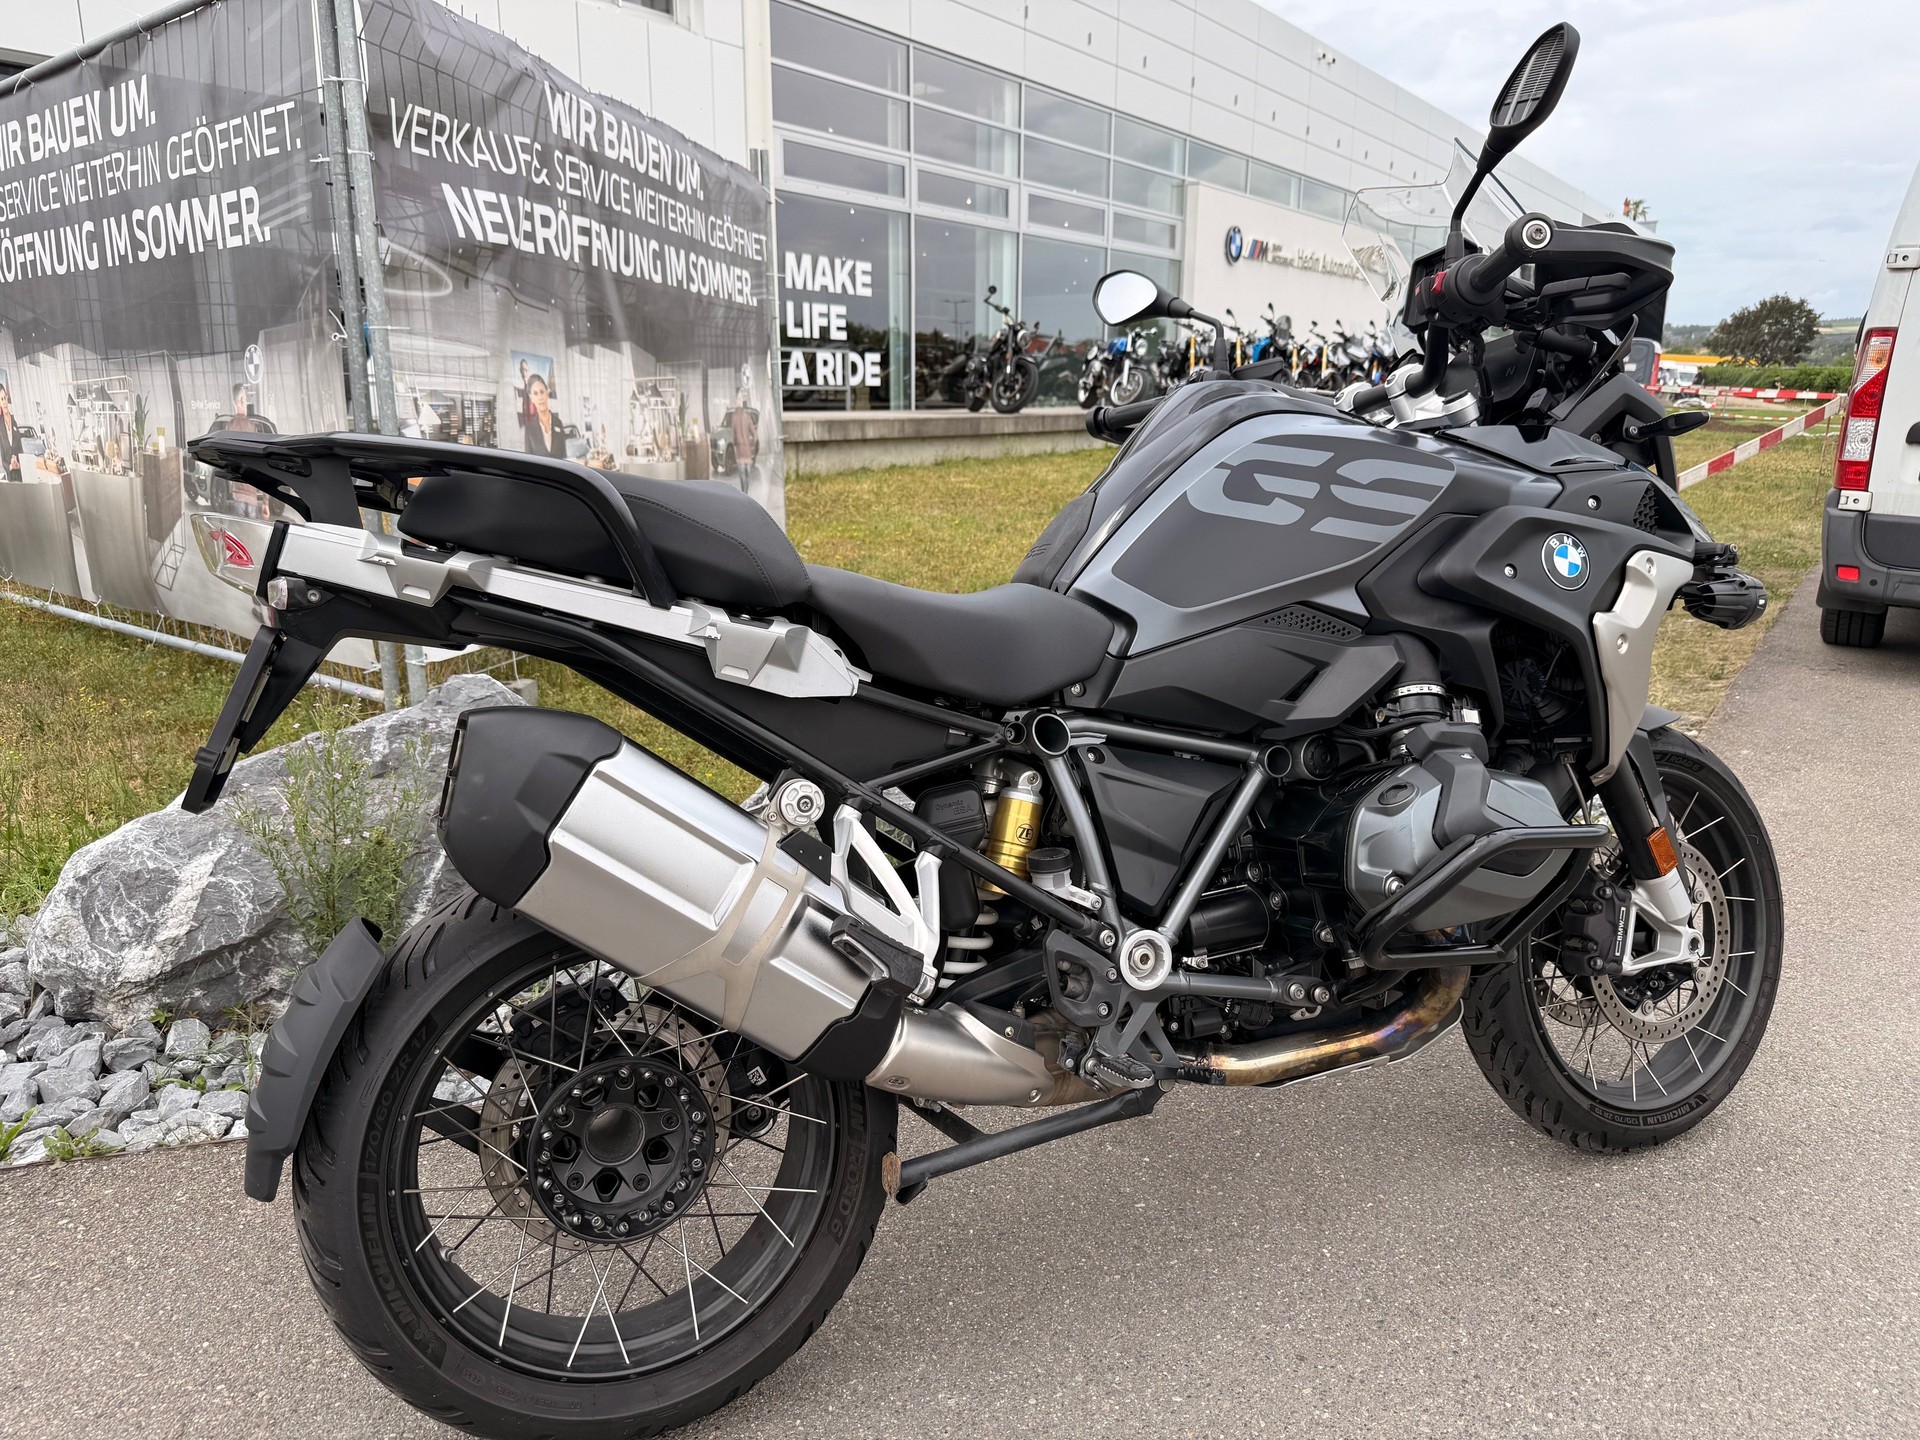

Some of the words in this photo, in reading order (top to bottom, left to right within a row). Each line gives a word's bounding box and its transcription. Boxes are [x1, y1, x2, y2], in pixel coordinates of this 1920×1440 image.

[26, 90, 102, 163] BAUEN
[110, 74, 156, 137] UM.
[60, 144, 161, 206] WEITERHIN
[166, 101, 301, 180] GEÖFFNET.
[544, 80, 598, 152] WIR
[602, 109, 671, 186] BAUEN
[675, 149, 704, 201] UM.
[390, 97, 531, 177] VERKAUF
[531, 142, 551, 186] &
[554, 149, 631, 215] SERVICE
[632, 182, 706, 243] WEITERHIN
[708, 214, 767, 262] GEÖFFNET
[0, 220, 100, 283] ÖFFNUNG
[102, 212, 133, 267] IM
[132, 186, 271, 263] SOMMER.
[441, 182, 662, 284] NEUERÖFFNUNG
[664, 244, 687, 290] IM
[689, 252, 758, 307] SOMMER.
[785, 251, 872, 297] MAKE
[786, 300, 847, 341] LIFE
[786, 350, 810, 386] A
[816, 350, 881, 387] RIDE
[1187, 443, 1454, 543] GS
[1549, 535, 1586, 558] BMW
[1669, 755, 1693, 768] ROAD
[935, 799, 964, 811] Dynamic
[953, 805, 974, 816] ESA
[1018, 826, 1034, 841] ZF
[1617, 919, 1625, 941] BMW
[364, 1089, 394, 1173] 170/60
[390, 1056, 413, 1085] ZR
[411, 1025, 430, 1050] 17
[1614, 1115, 1639, 1125] 120/70
[1646, 1103, 1691, 1125] MICHELIN
[362, 1192, 417, 1325] MICHELIN
